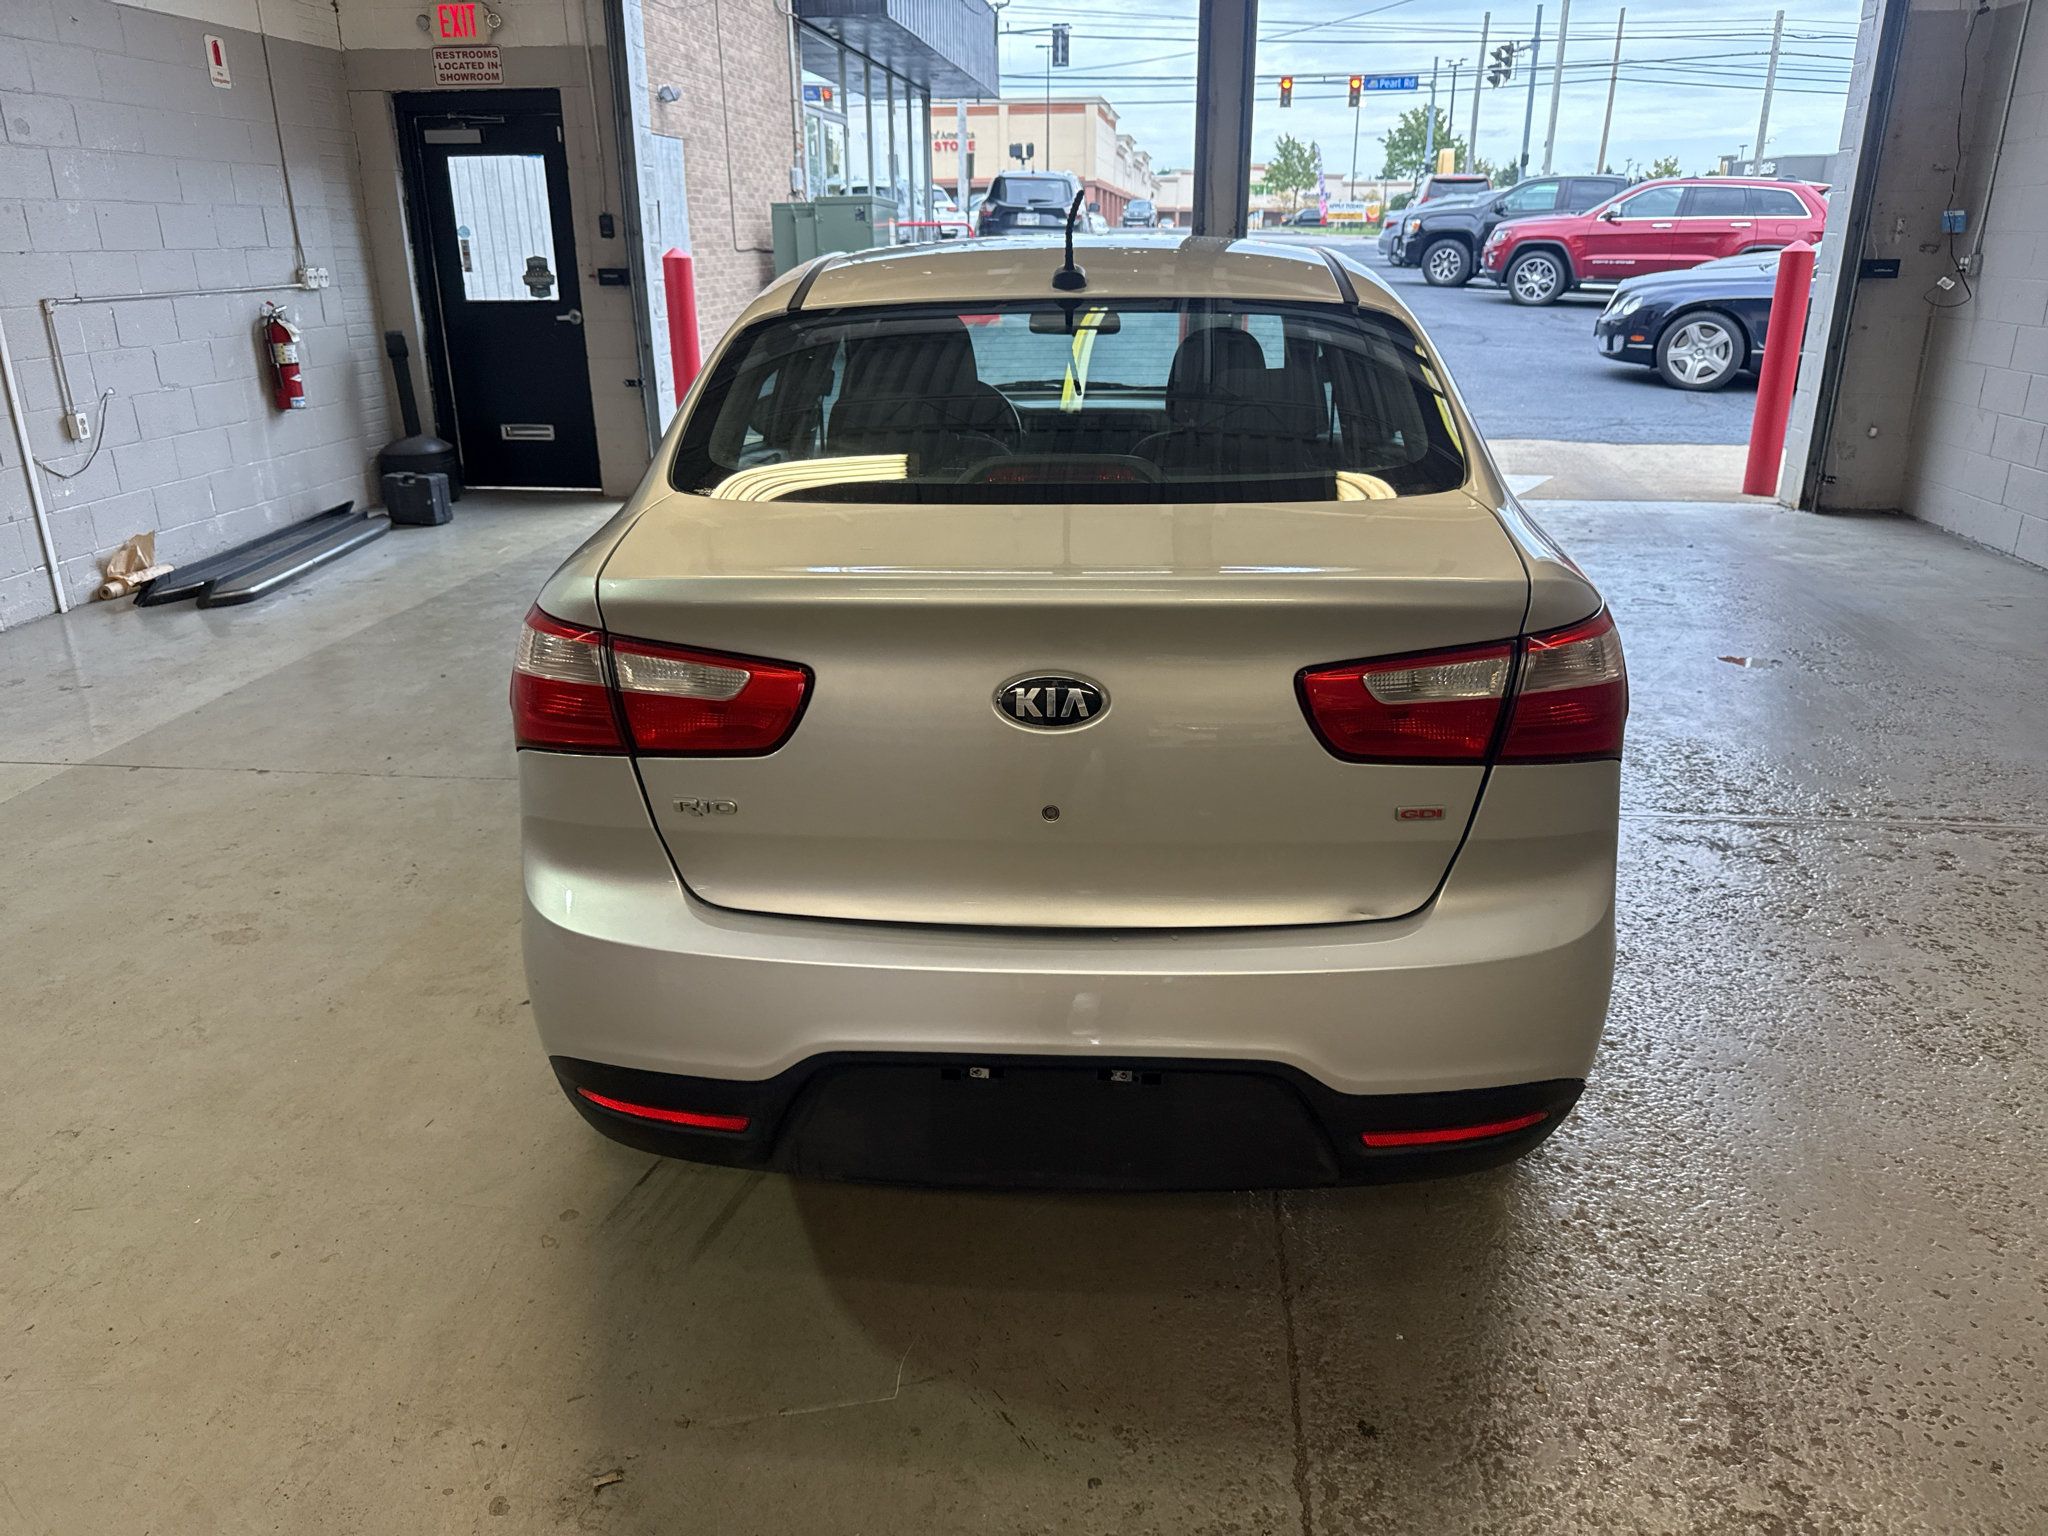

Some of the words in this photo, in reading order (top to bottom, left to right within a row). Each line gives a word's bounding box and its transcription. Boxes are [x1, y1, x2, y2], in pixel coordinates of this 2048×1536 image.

[437, 3, 476, 38] EXIT
[435, 51, 498, 60] RESTROOMS
[438, 62, 485, 71] LOCATED
[487, 61, 498, 70] IN
[440, 73, 499, 81] SHOWROOM
[1380, 79, 1401, 88] Pearl
[1404, 78, 1415, 88] Rd
[934, 141, 976, 152] STOE
[1015, 687, 1090, 718] KIA
[672, 798, 738, 817] RIO
[1400, 809, 1443, 819] GDI
